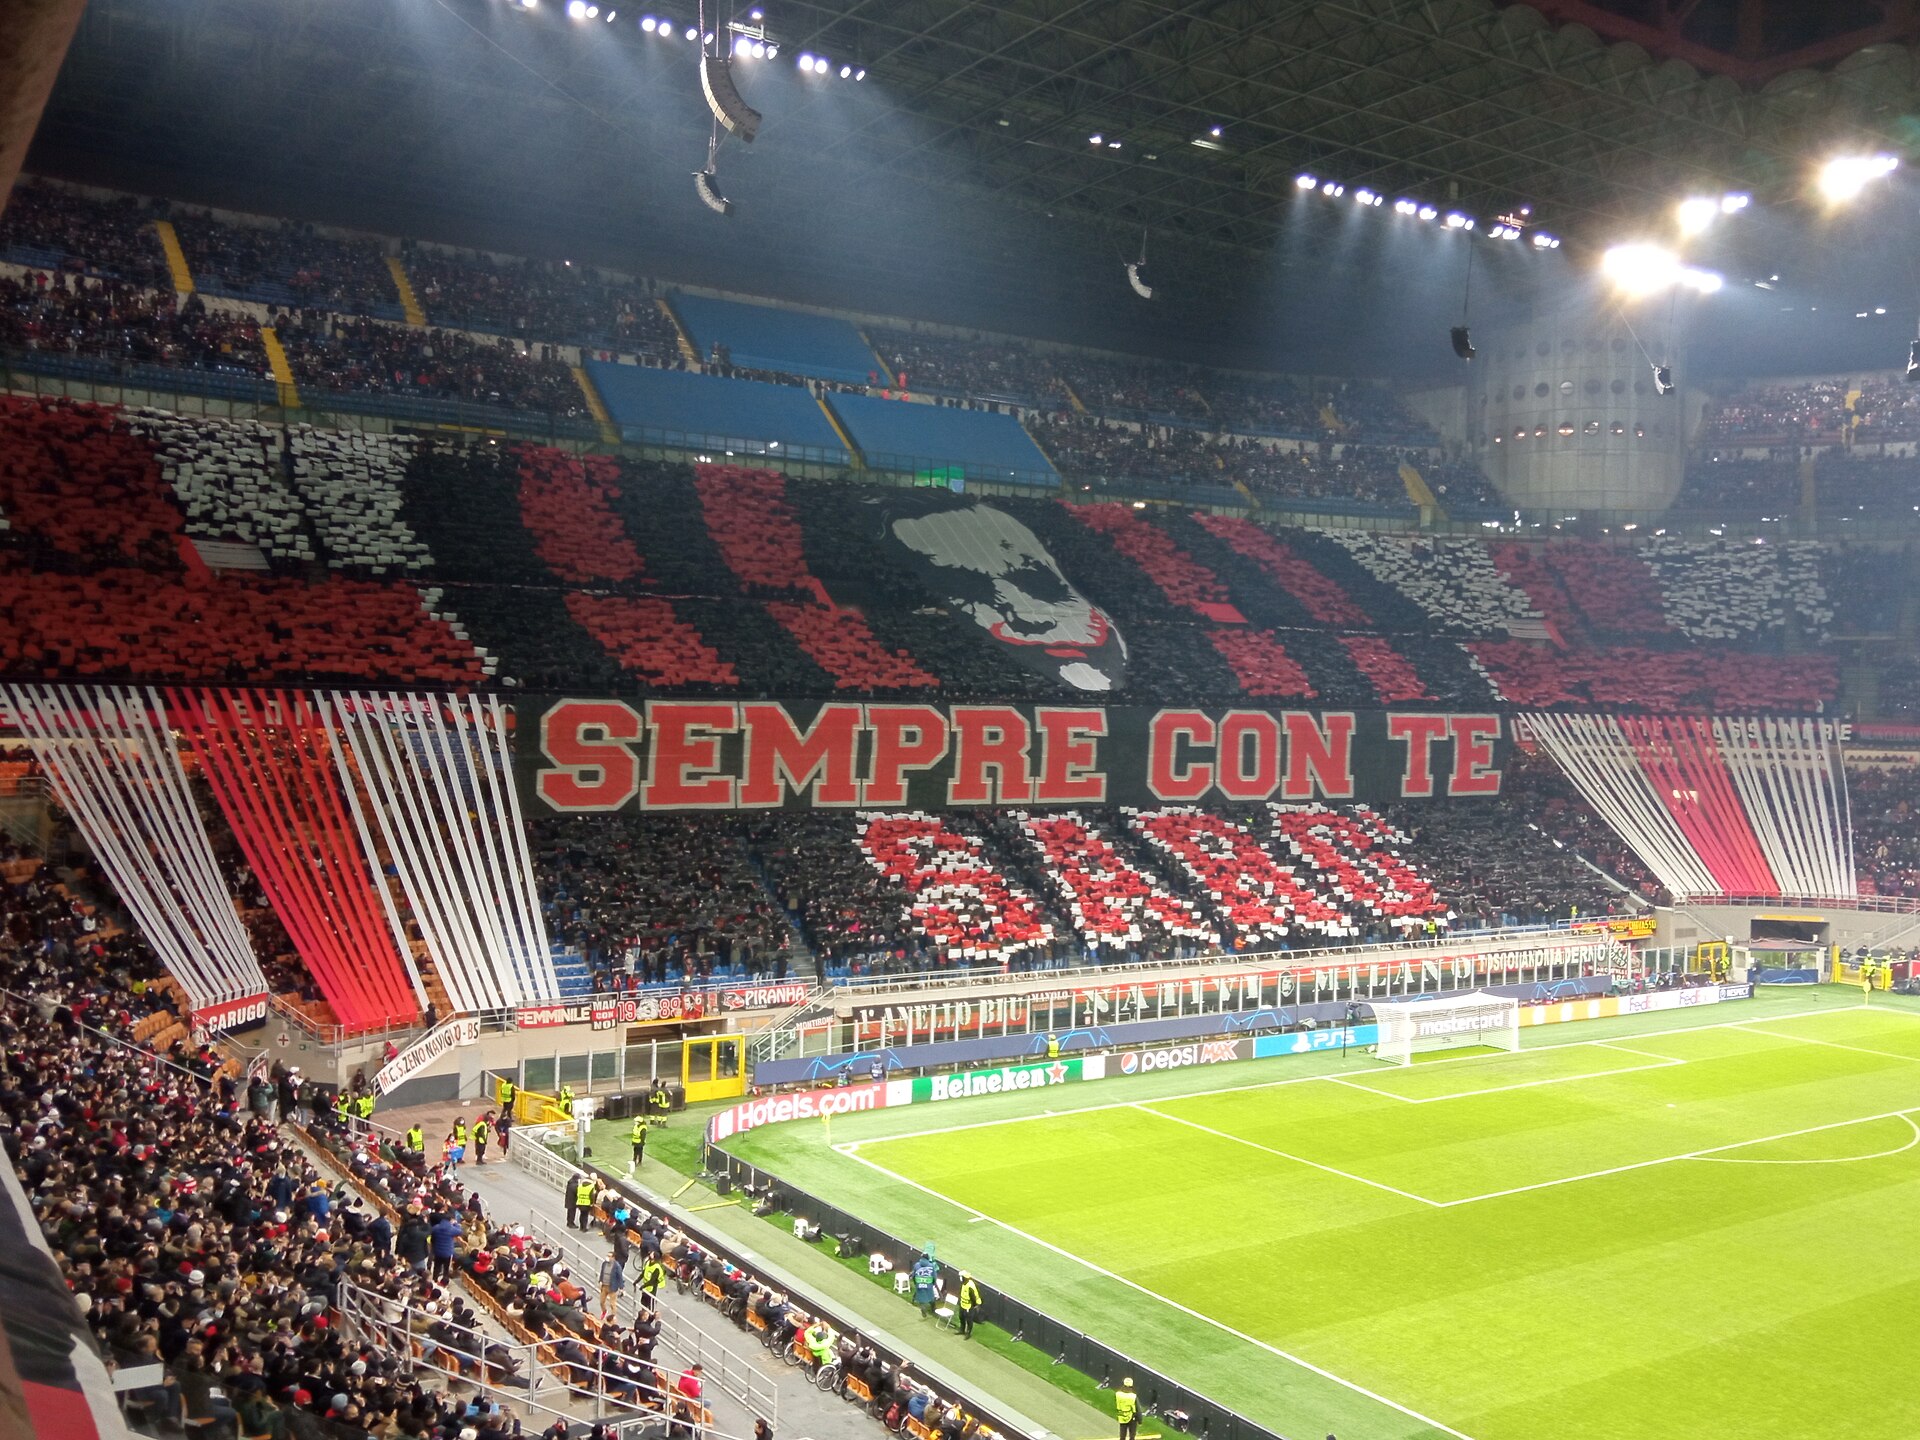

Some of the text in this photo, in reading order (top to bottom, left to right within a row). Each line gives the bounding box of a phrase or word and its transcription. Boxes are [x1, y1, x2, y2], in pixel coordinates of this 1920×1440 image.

[536, 699, 1503, 812] SEMPRE CON TE
[1312, 957, 1472, 993] MILANO
[745, 985, 806, 1007] PIRANHA
[1726, 986, 1750, 997] RESPECT
[593, 999, 616, 1011] MAU
[617, 1001, 637, 1022] 19
[1629, 994, 1658, 1012] FedE
[208, 1001, 266, 1034] CARUGO
[517, 1006, 591, 1025] FEMMINILE
[594, 1020, 616, 1030] NOI
[884, 1001, 972, 1033] ANELLO
[1420, 1008, 1504, 1036] mastercard
[467, 1022, 479, 1040] BS
[1313, 1029, 1357, 1048] PS5
[1141, 1040, 1240, 1073] pepsi MAX
[931, 1065, 1046, 1102] Heineken
